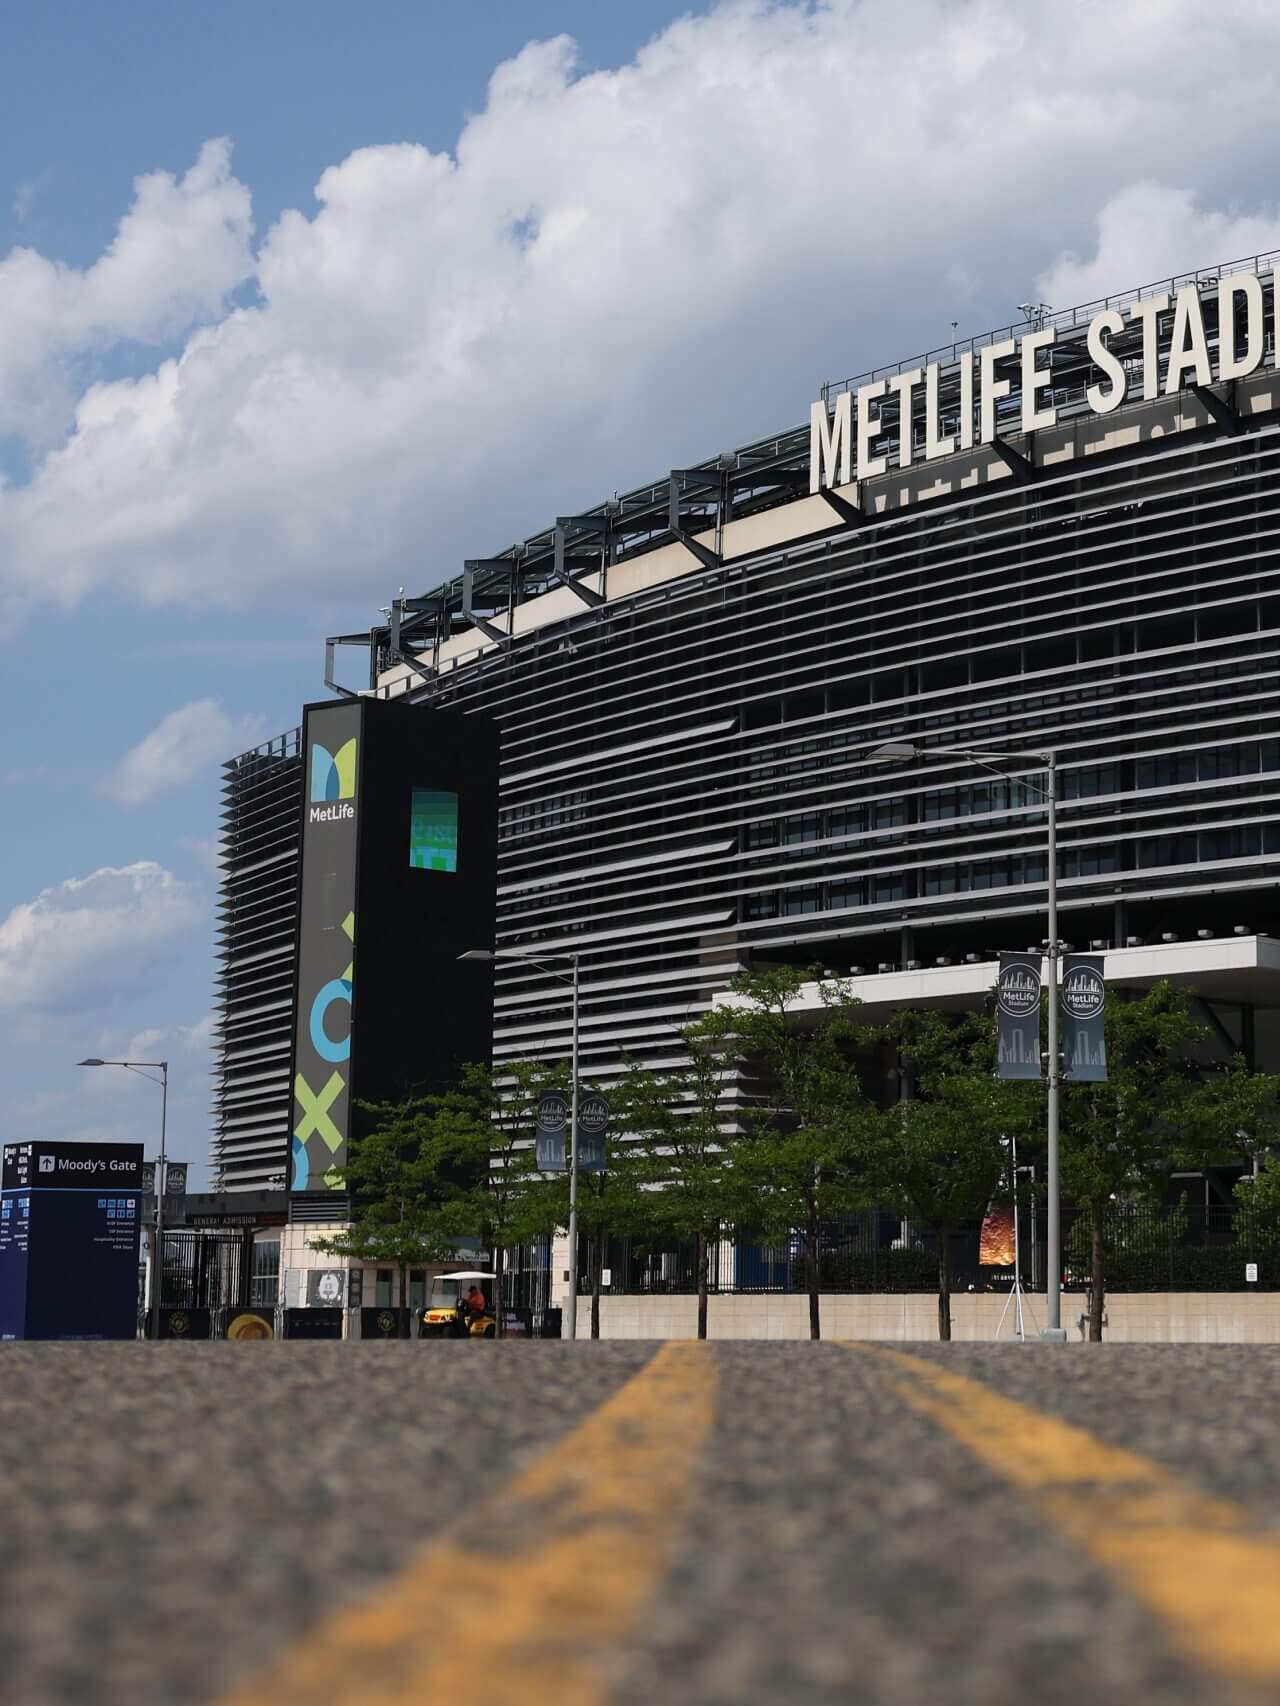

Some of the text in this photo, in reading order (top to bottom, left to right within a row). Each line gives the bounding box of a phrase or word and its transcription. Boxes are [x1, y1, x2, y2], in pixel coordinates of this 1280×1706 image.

[809, 328, 1058, 494] METLIFE
[309, 803, 355, 823] MetLife
[1003, 991, 1035, 1001] MetLife
[1067, 993, 1100, 1003] MetLife
[58, 1159, 137, 1174] Moody's Gate
